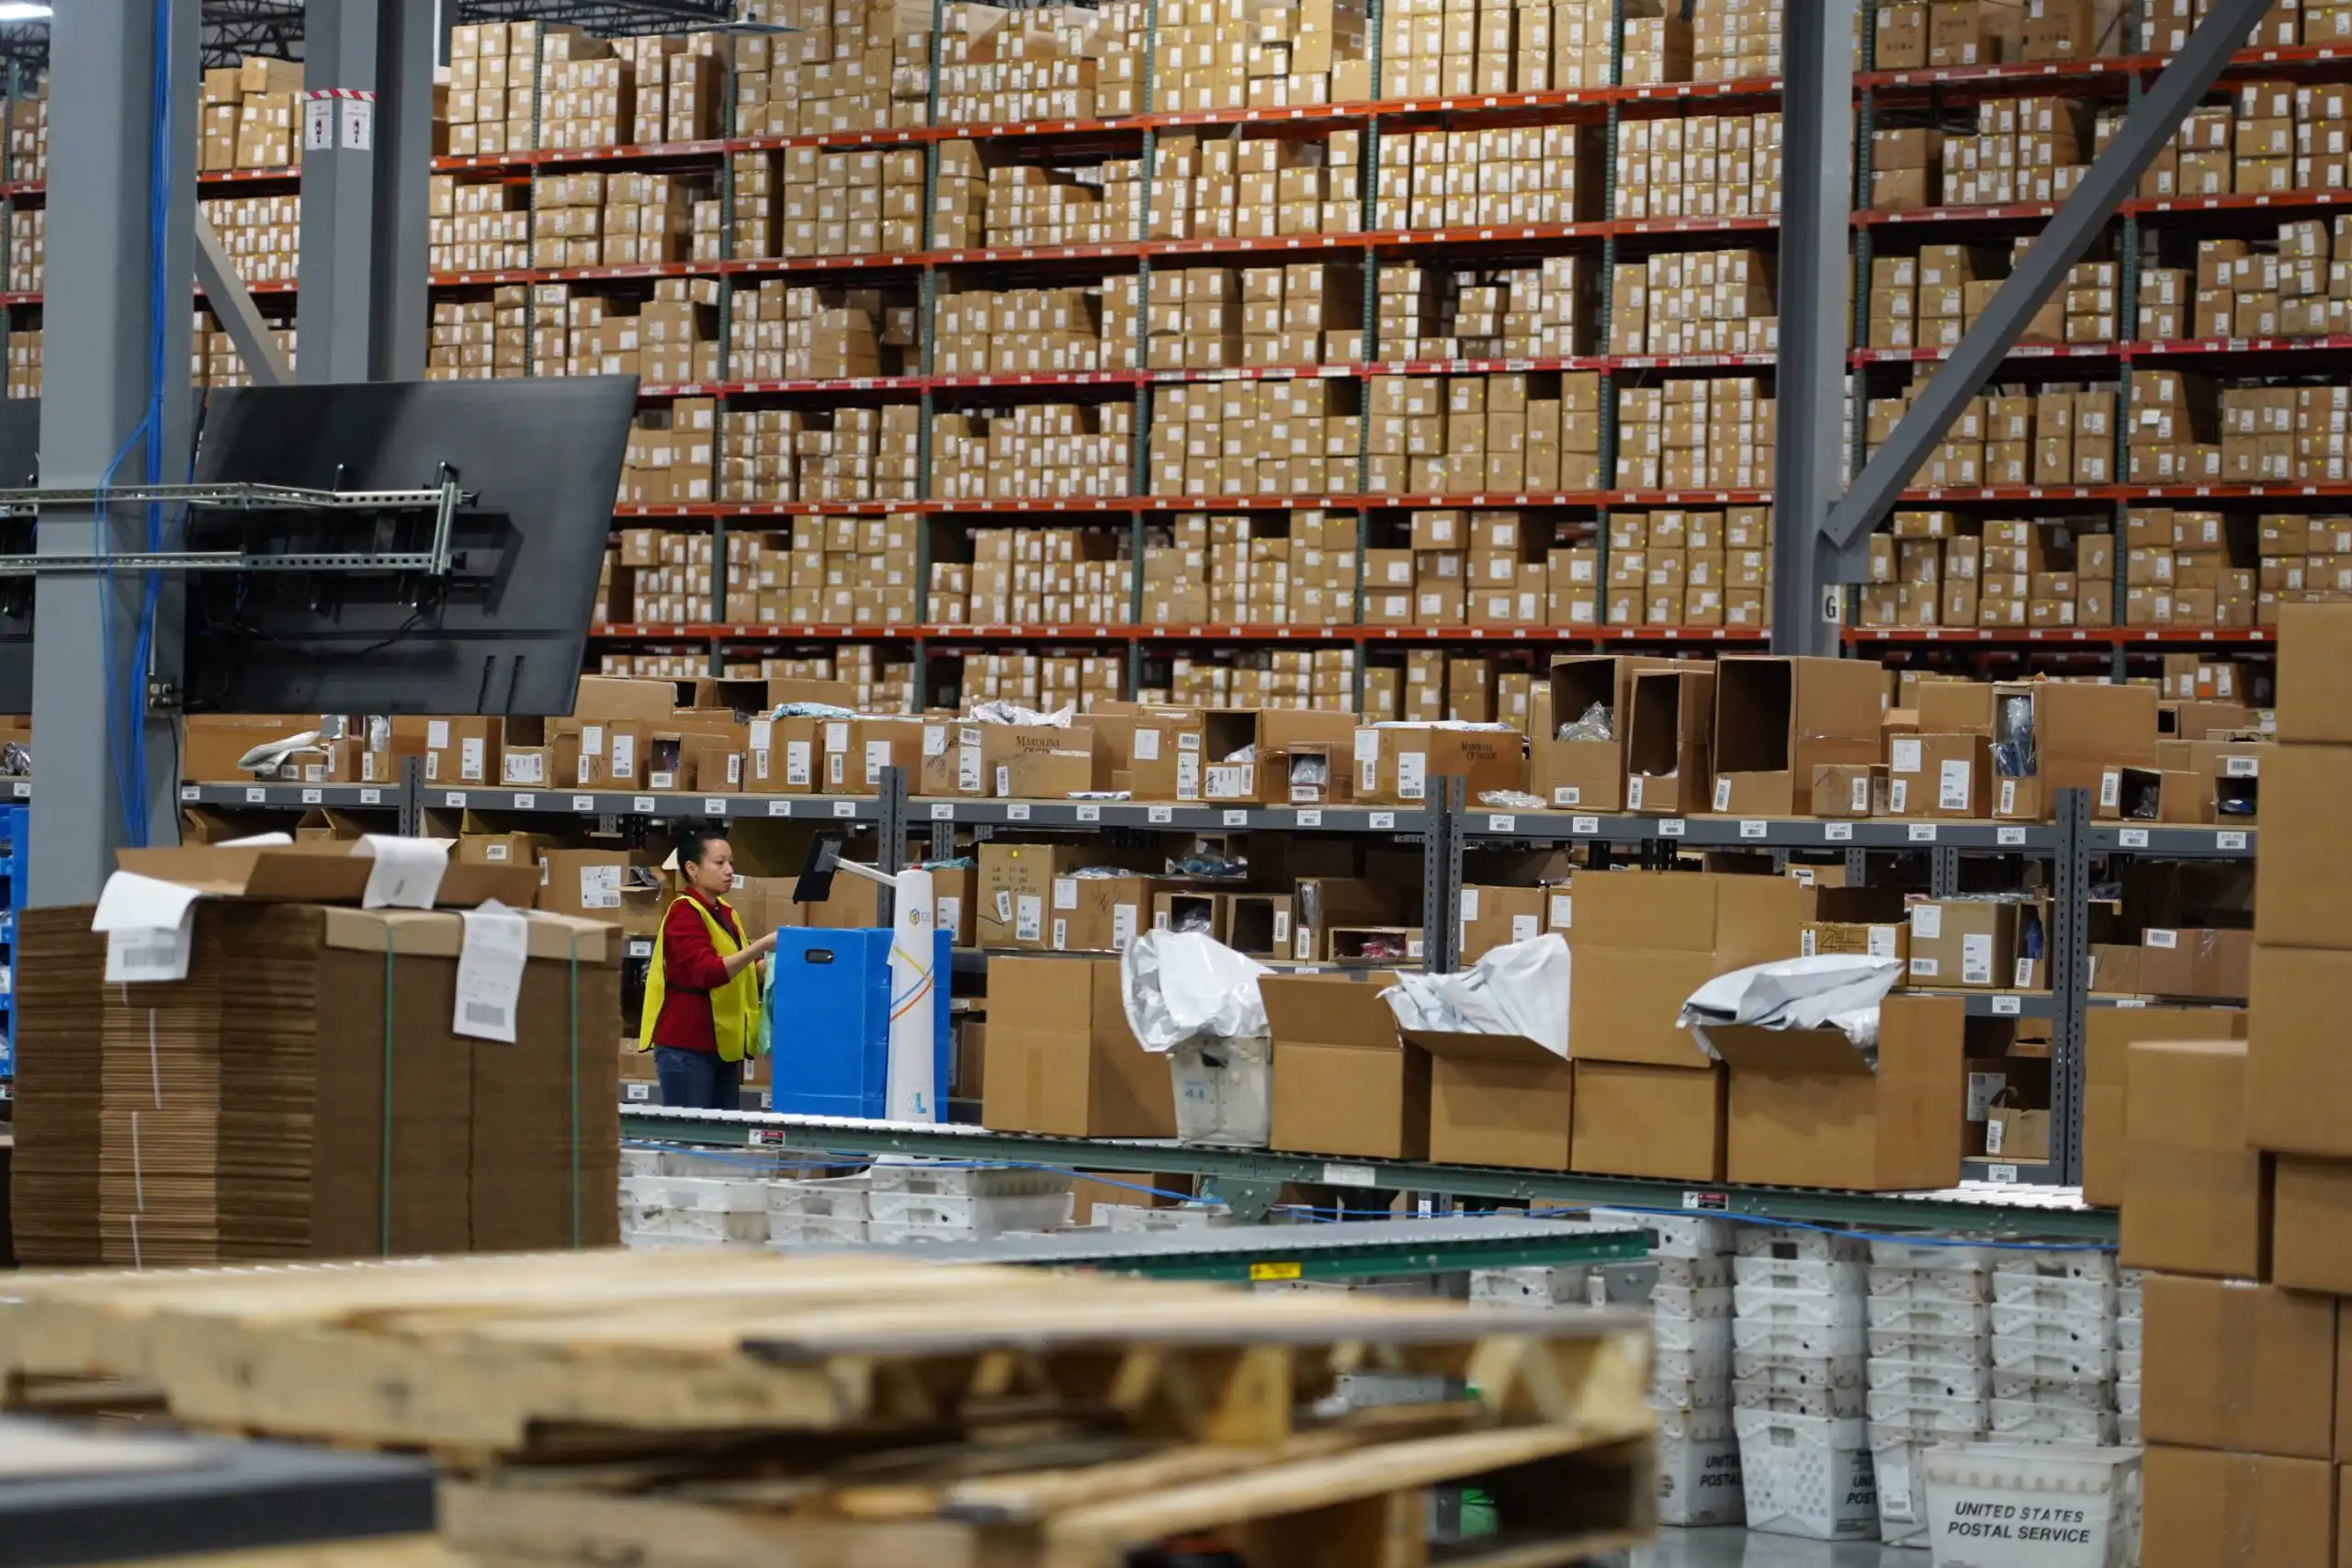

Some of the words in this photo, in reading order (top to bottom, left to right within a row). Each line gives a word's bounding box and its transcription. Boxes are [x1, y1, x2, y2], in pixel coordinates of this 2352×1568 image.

[1825, 595, 1836, 619] G
[1955, 1501, 2016, 1519] UNITED
[2019, 1506, 2084, 1523] STATES
[1948, 1521, 2012, 1539] POSTAL
[2018, 1526, 2090, 1544] SERVICE
